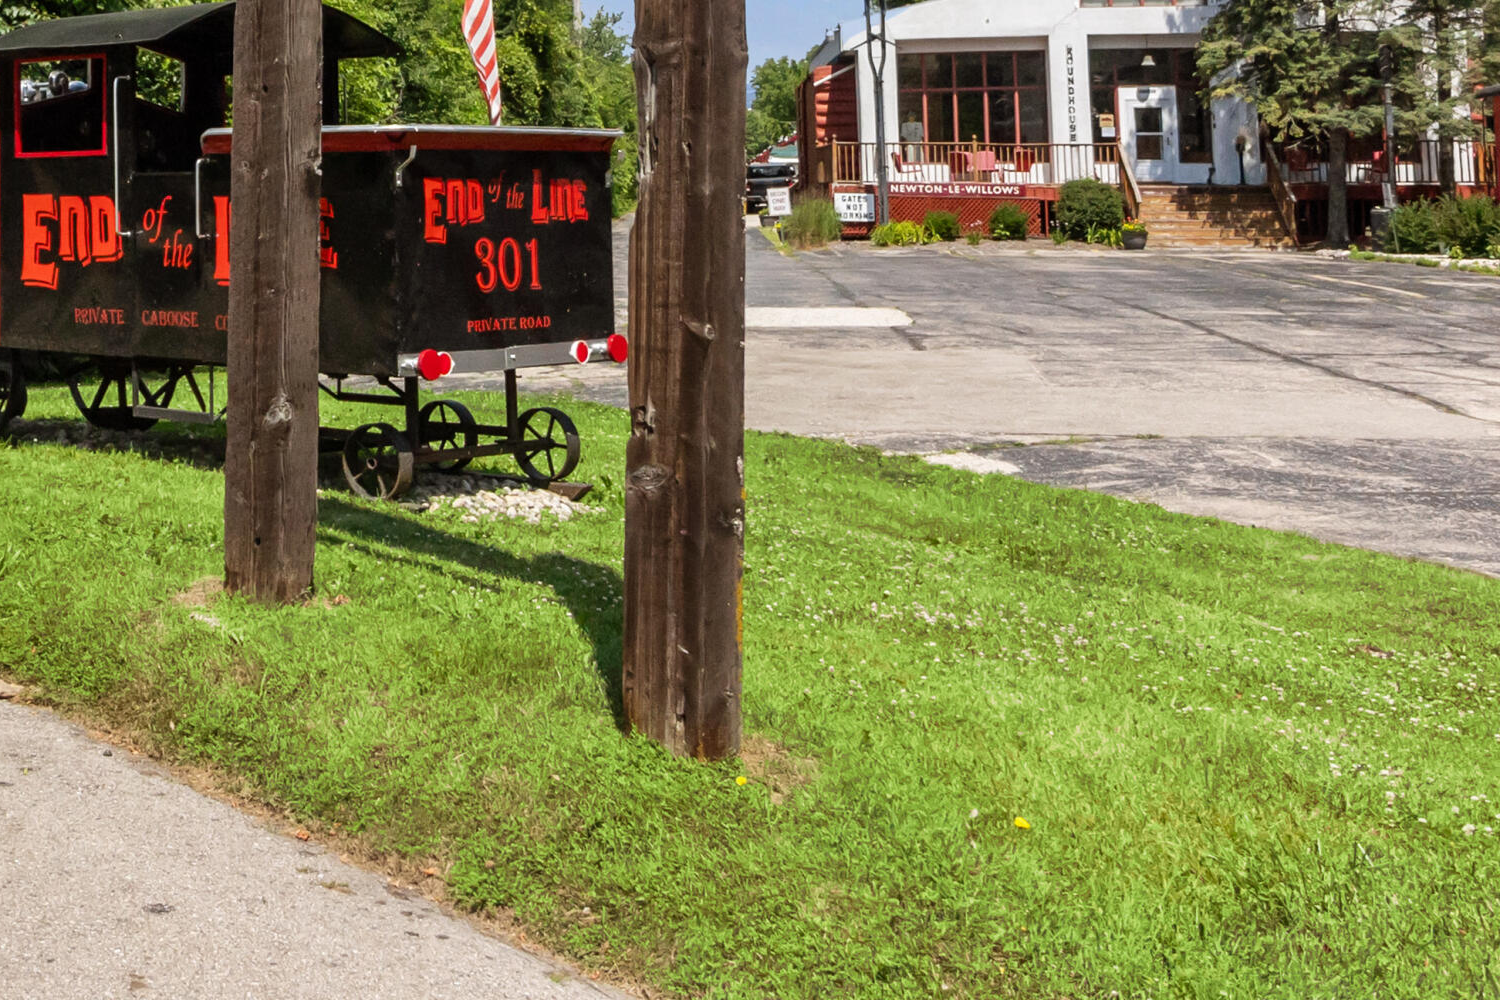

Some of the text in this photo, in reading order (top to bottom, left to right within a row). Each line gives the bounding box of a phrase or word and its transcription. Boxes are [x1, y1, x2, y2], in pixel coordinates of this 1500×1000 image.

[488, 171, 506, 203] of
[506, 183, 525, 209] the
[841, 195, 869, 203] GATES
[890, 184, 1020, 195] NEWTON-LE-WILLOWS
[846, 203, 863, 211] NOT
[143, 196, 172, 243] of
[162, 229, 193, 268] the
[474, 237, 542, 294] 301
[74, 307, 125, 325] PRIVATE
[141, 310, 199, 328] CABOOSE
[467, 315, 551, 333] PRIVATE ROAD
